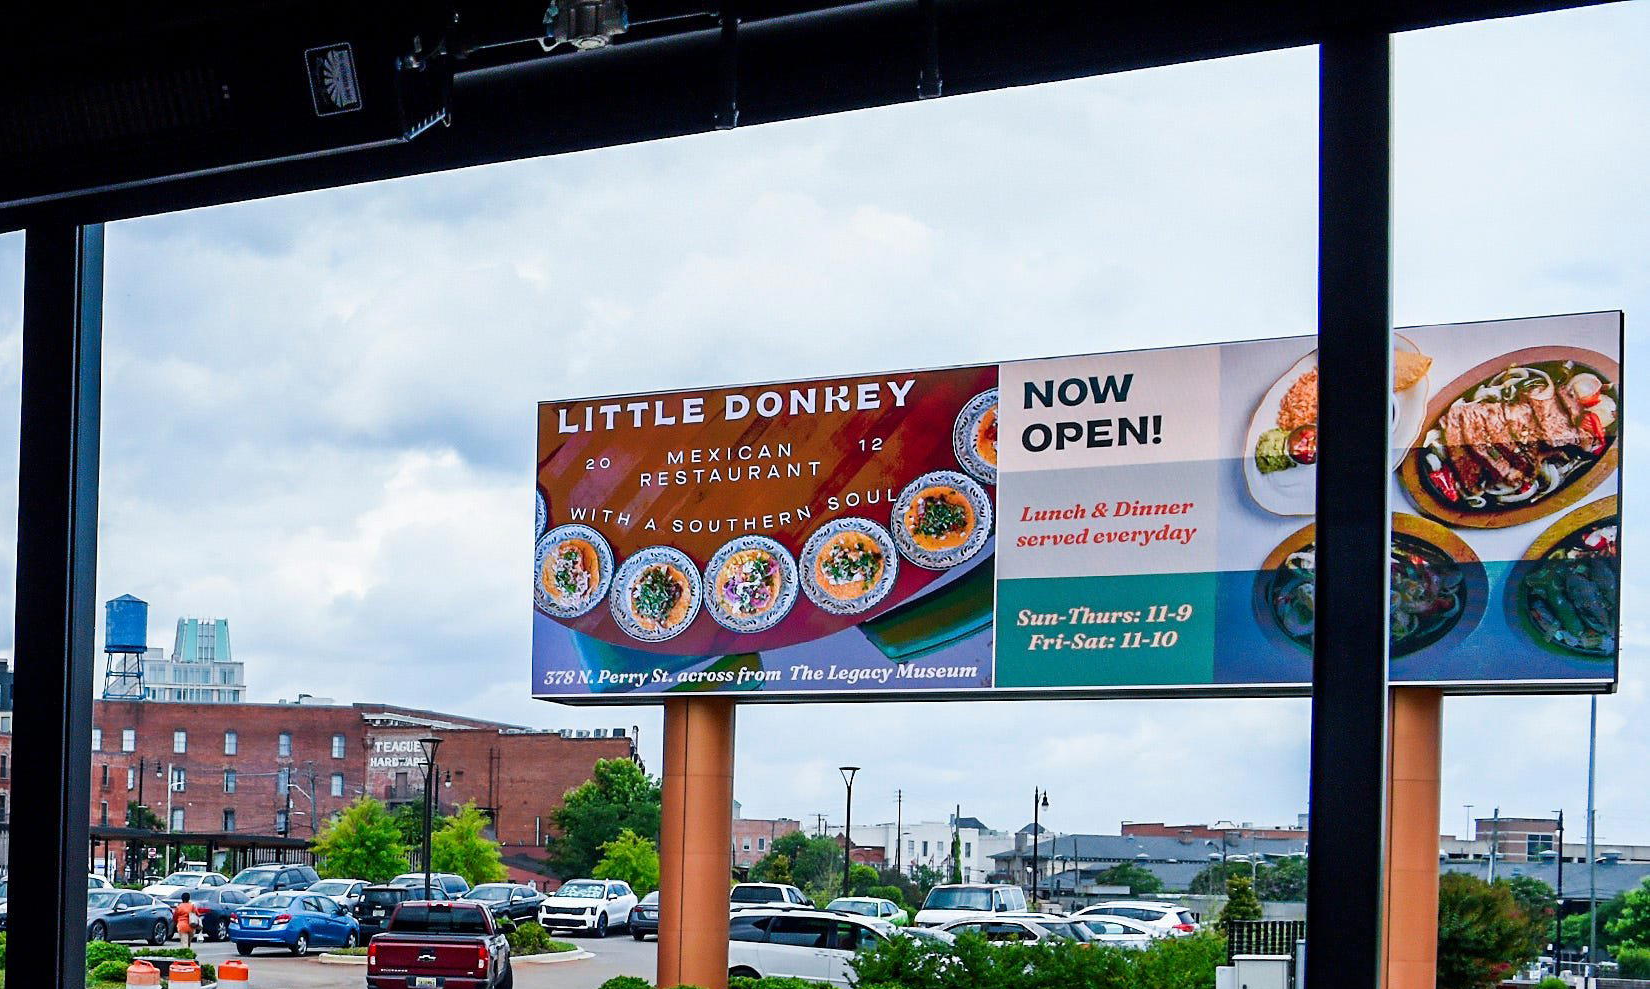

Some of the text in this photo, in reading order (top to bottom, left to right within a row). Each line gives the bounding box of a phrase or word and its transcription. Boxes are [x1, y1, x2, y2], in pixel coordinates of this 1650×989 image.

[1023, 373, 1134, 409] NOW
[558, 379, 916, 434] LITTLE DONKEY
[858, 438, 884, 452] 12
[1021, 414, 1163, 453] OPEN!
[585, 457, 611, 470] 20
[666, 443, 793, 465] MEXICAN
[639, 461, 822, 488] RESTAURANT
[569, 489, 898, 534] WITH A SOUTHERN SOUL
[1019, 499, 1195, 523] Lunch & Dinner
[1016, 524, 1198, 548] served everyday
[1017, 604, 1193, 627] Sun-Thurs: 11-9
[1027, 629, 1179, 651] Fri-Sat: 11-10
[543, 663, 978, 688] 378 N. Perry St. across from The Legacy Museum
[375, 741, 422, 753] TEAGUE
